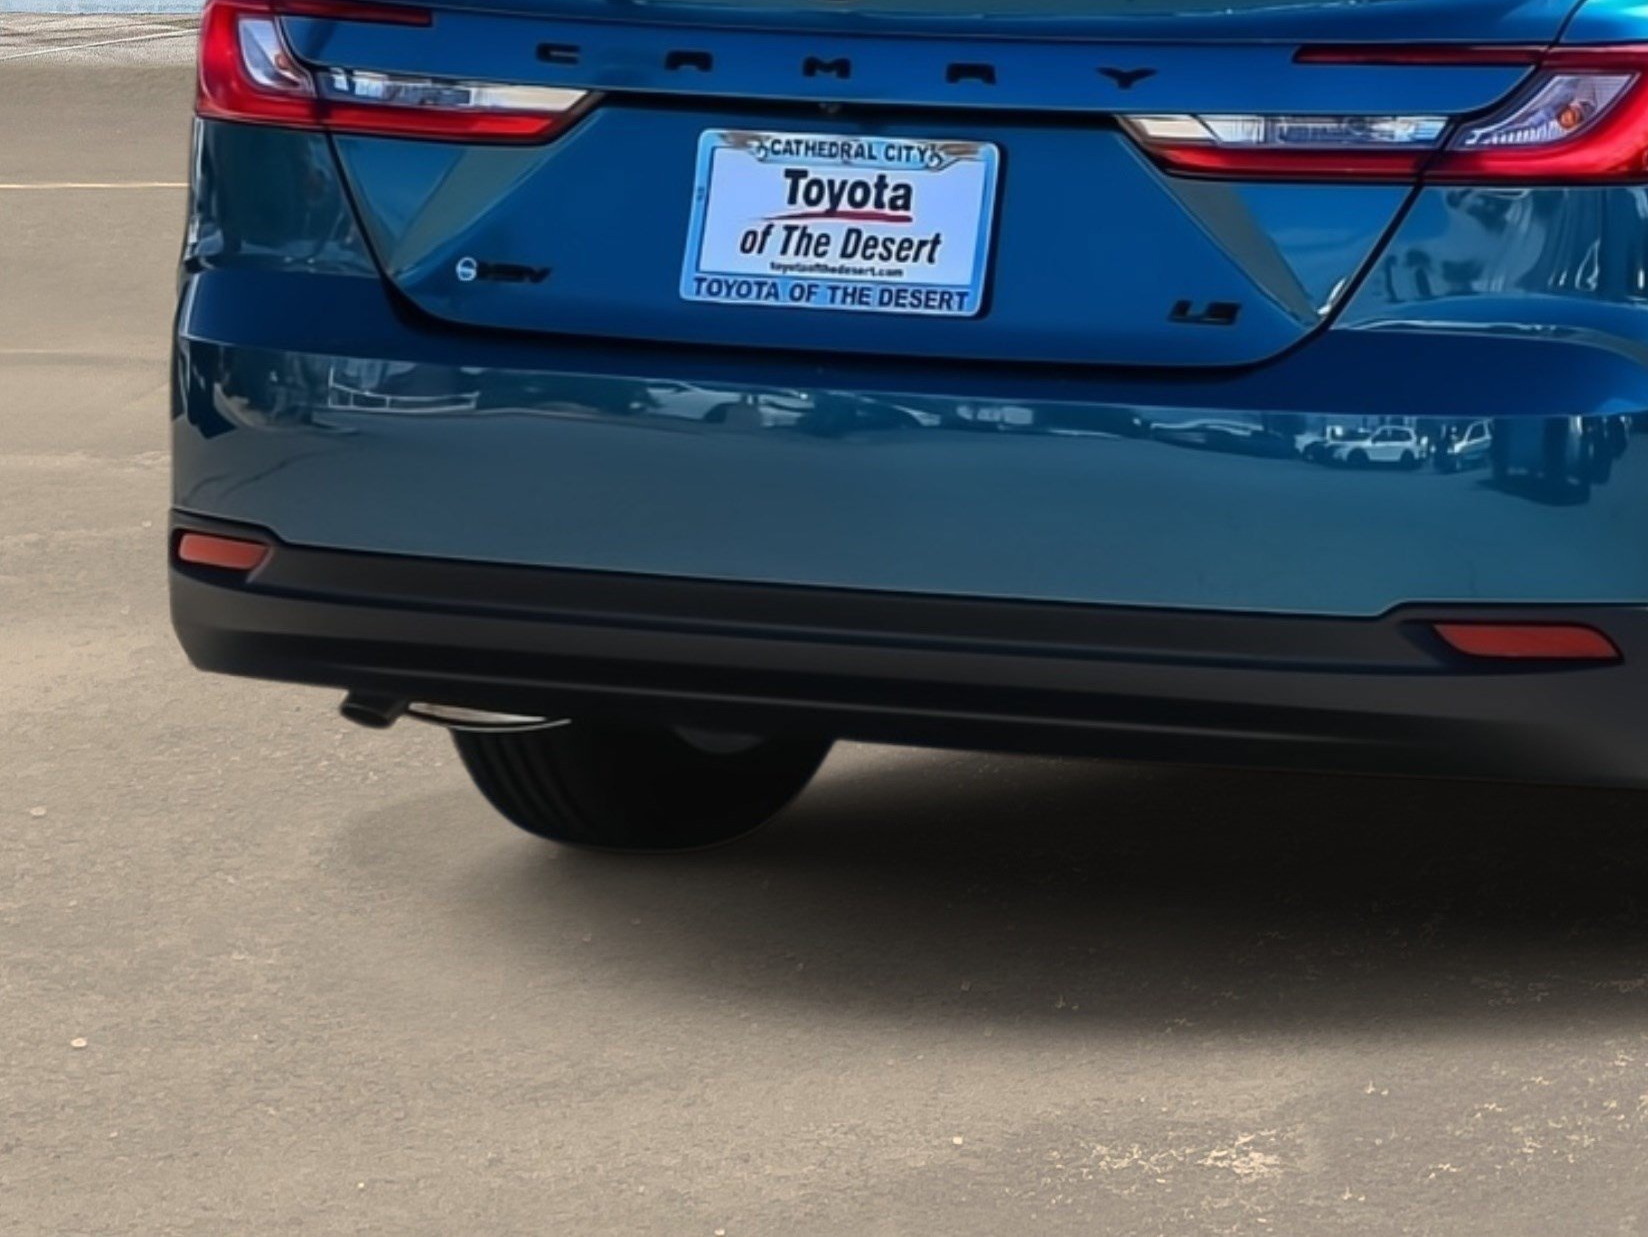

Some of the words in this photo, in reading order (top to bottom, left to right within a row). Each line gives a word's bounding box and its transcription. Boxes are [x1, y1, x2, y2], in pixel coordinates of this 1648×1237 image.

[769, 138, 877, 161] CATHEDRAL
[884, 143, 928, 163] CITY
[783, 168, 913, 212] Toyota
[740, 223, 775, 254] of
[780, 224, 831, 258] The
[840, 228, 941, 264] Desert
[693, 276, 781, 301] TOYOTA
[789, 282, 820, 303] OF
[828, 285, 871, 306] THE
[879, 288, 969, 311] DESERT
